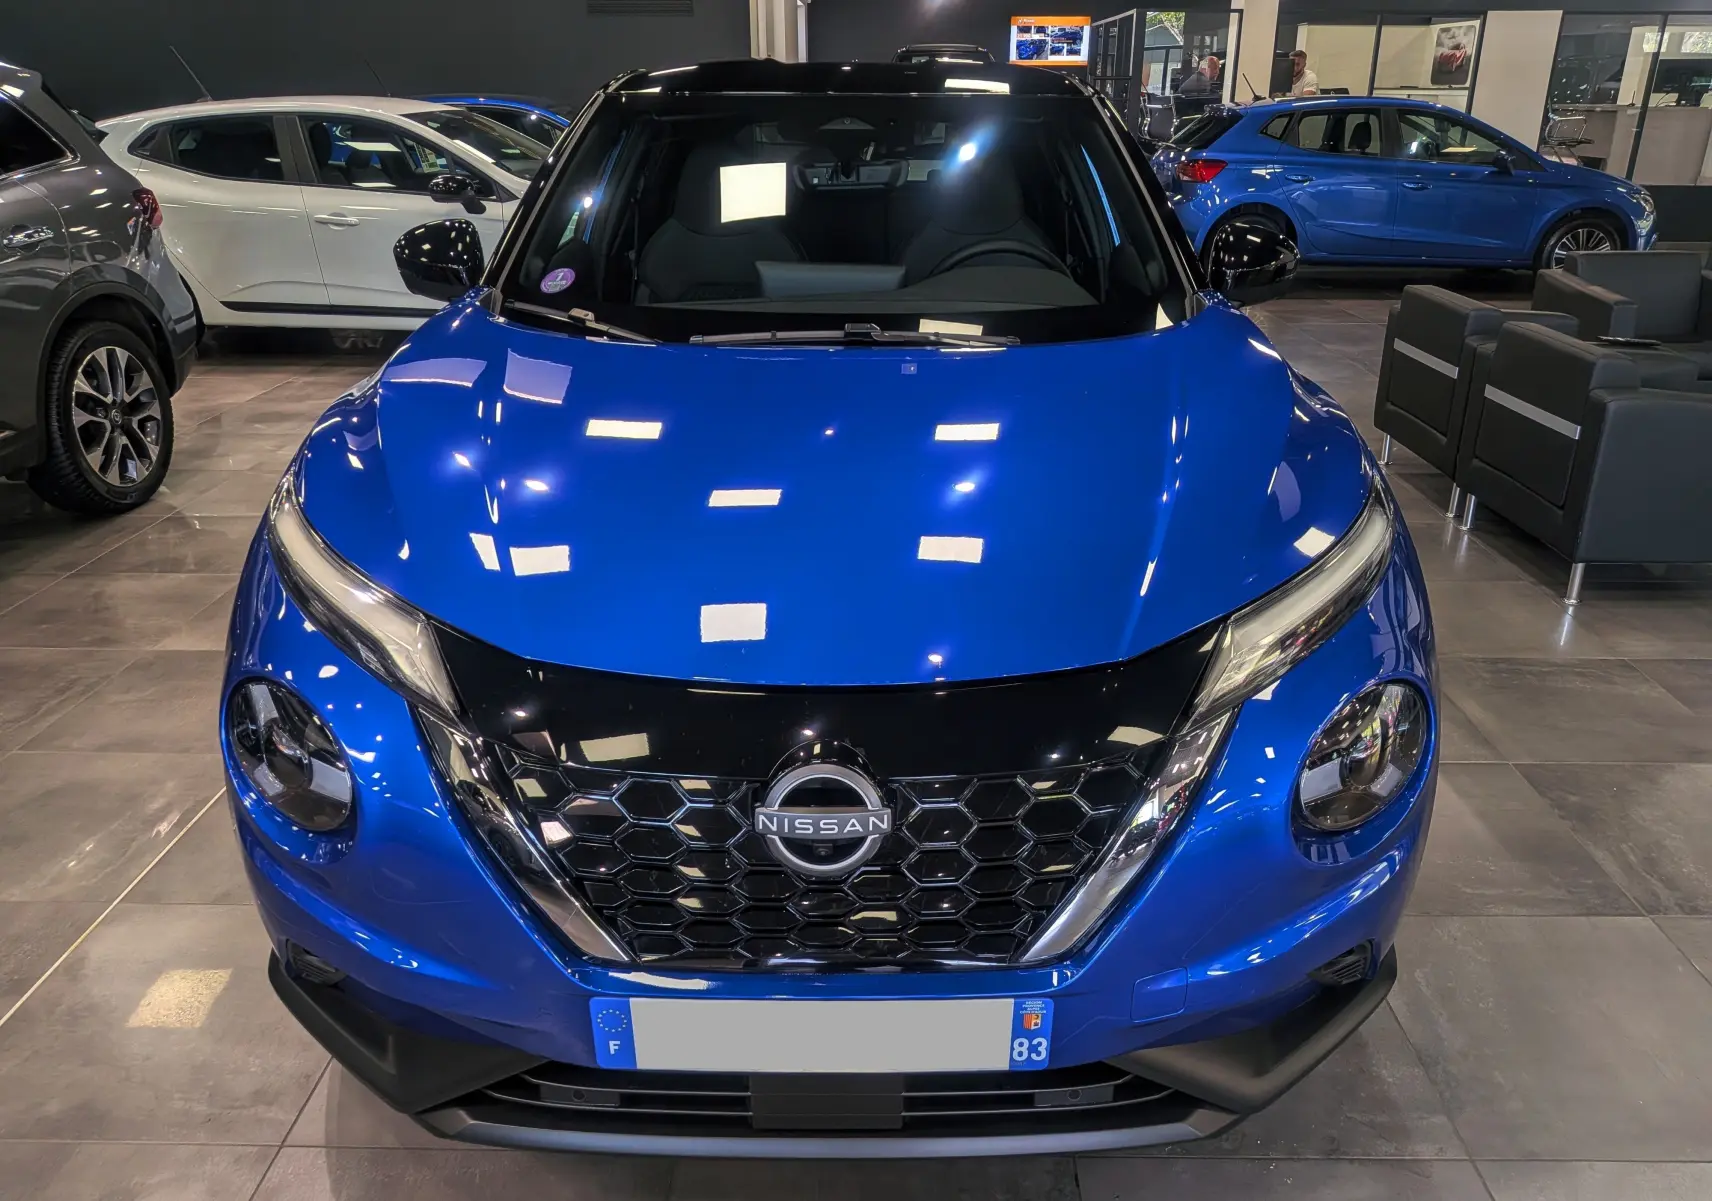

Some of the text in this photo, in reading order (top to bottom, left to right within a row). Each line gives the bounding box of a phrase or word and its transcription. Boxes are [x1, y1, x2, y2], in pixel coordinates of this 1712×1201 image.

[758, 814, 888, 834] NISSAN
[608, 1040, 621, 1055] F
[1012, 1037, 1048, 1062] 83
